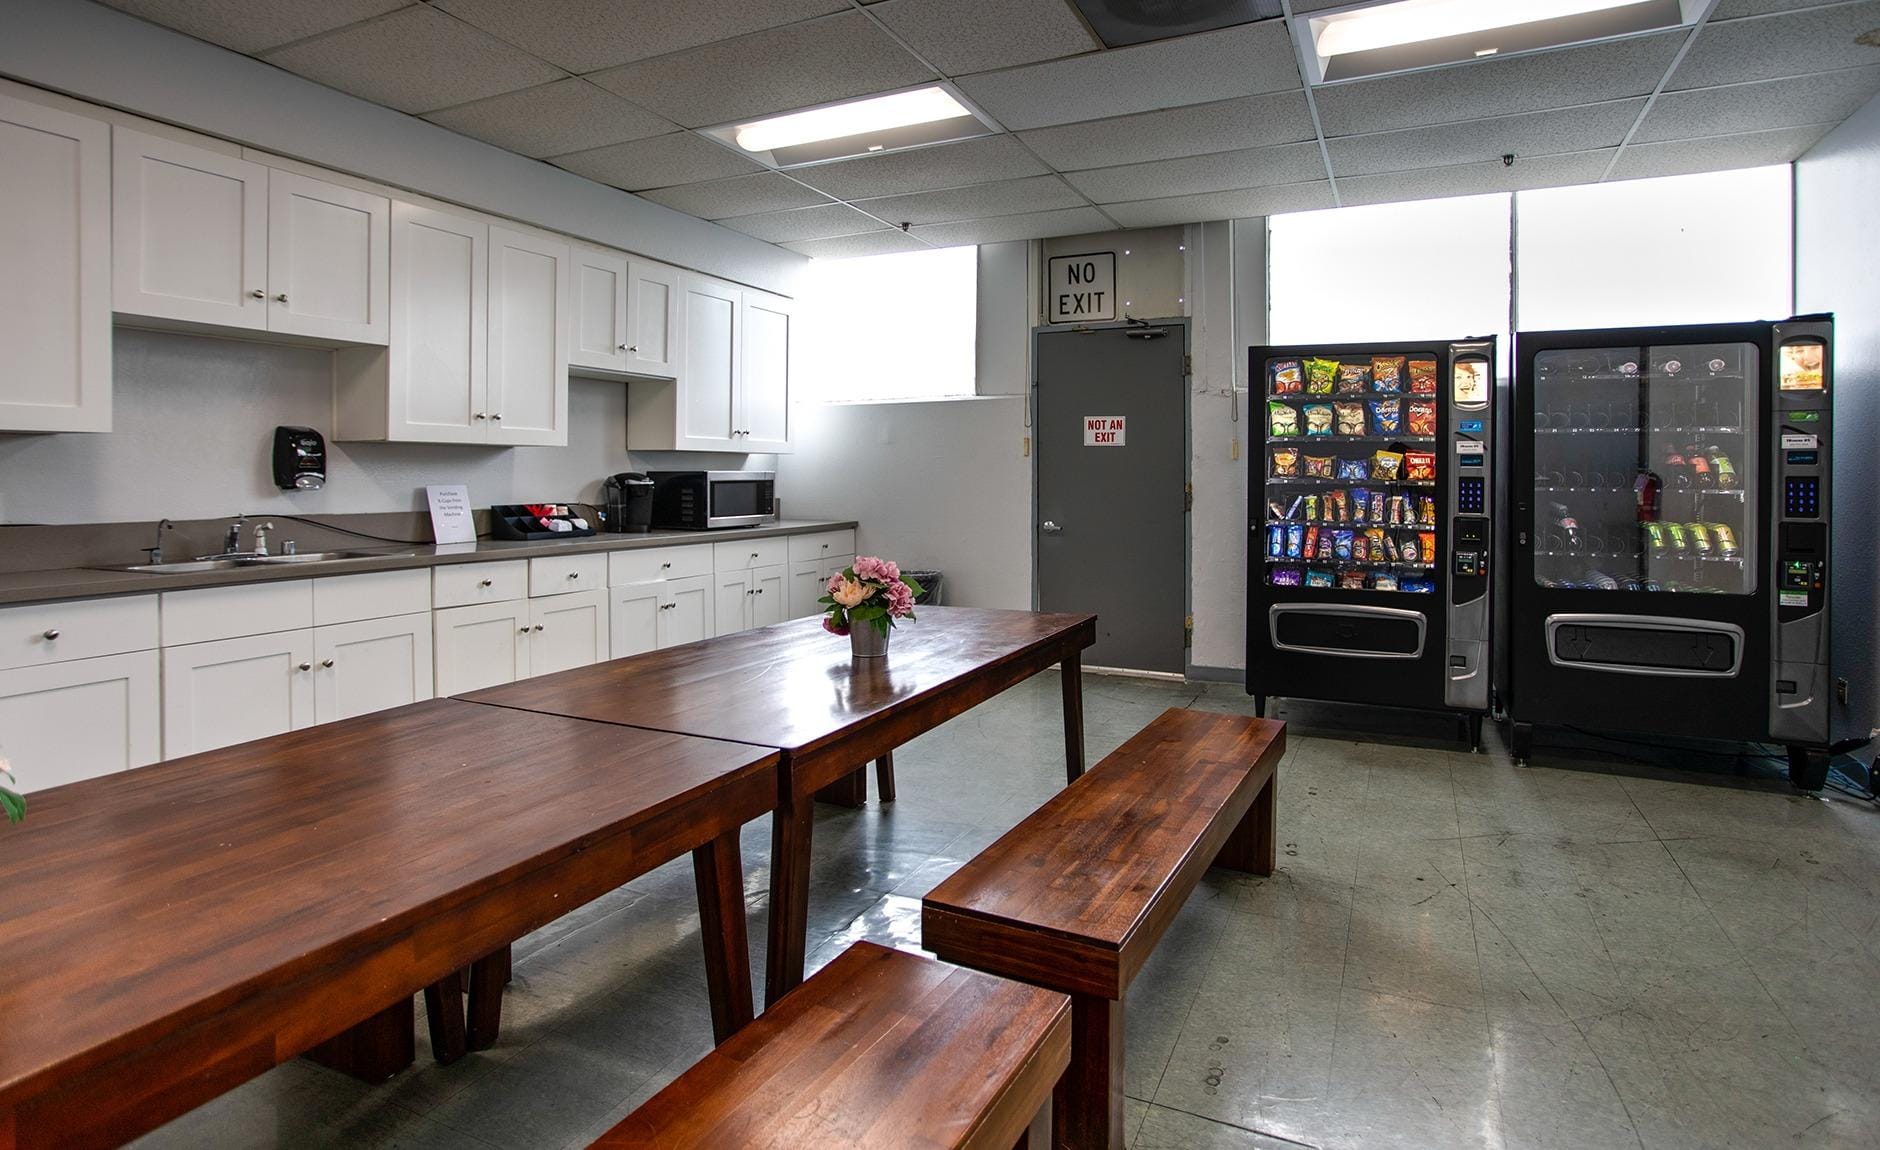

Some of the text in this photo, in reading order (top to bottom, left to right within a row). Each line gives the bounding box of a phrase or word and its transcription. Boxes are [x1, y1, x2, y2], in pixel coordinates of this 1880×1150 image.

[1068, 262, 1095, 285] NO
[1060, 291, 1105, 315] EXIT
[1088, 419, 1123, 430] NOT AN
[1095, 432, 1116, 443] EXIT
